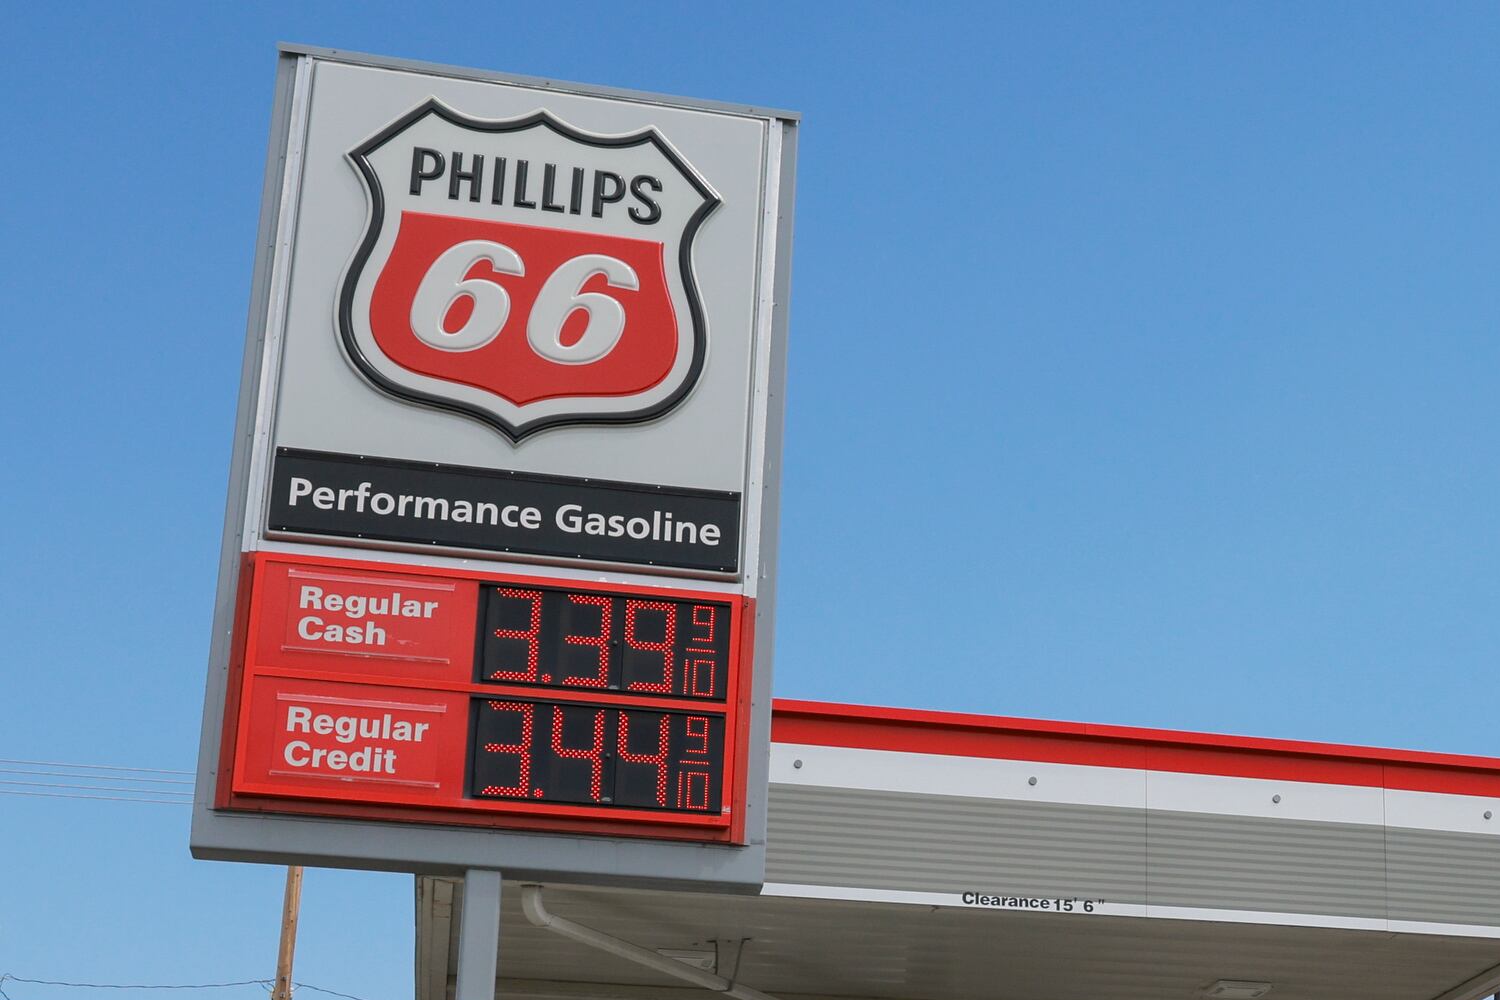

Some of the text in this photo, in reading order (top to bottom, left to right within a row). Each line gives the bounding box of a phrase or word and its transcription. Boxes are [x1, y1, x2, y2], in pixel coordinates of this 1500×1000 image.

[409, 146, 663, 225] PHILLIPS
[409, 239, 640, 366] 66
[288, 477, 722, 546] Performance Gasoline
[300, 585, 438, 624] Regular
[692, 605, 715, 642] 9
[298, 615, 386, 646] Cash
[489, 587, 677, 694] 3.39
[286, 706, 429, 744] Regular
[685, 716, 709, 754] 9
[283, 740, 397, 775] Credit
[481, 700, 670, 807] 3.44
[962, 892, 1050, 909] Clearance
